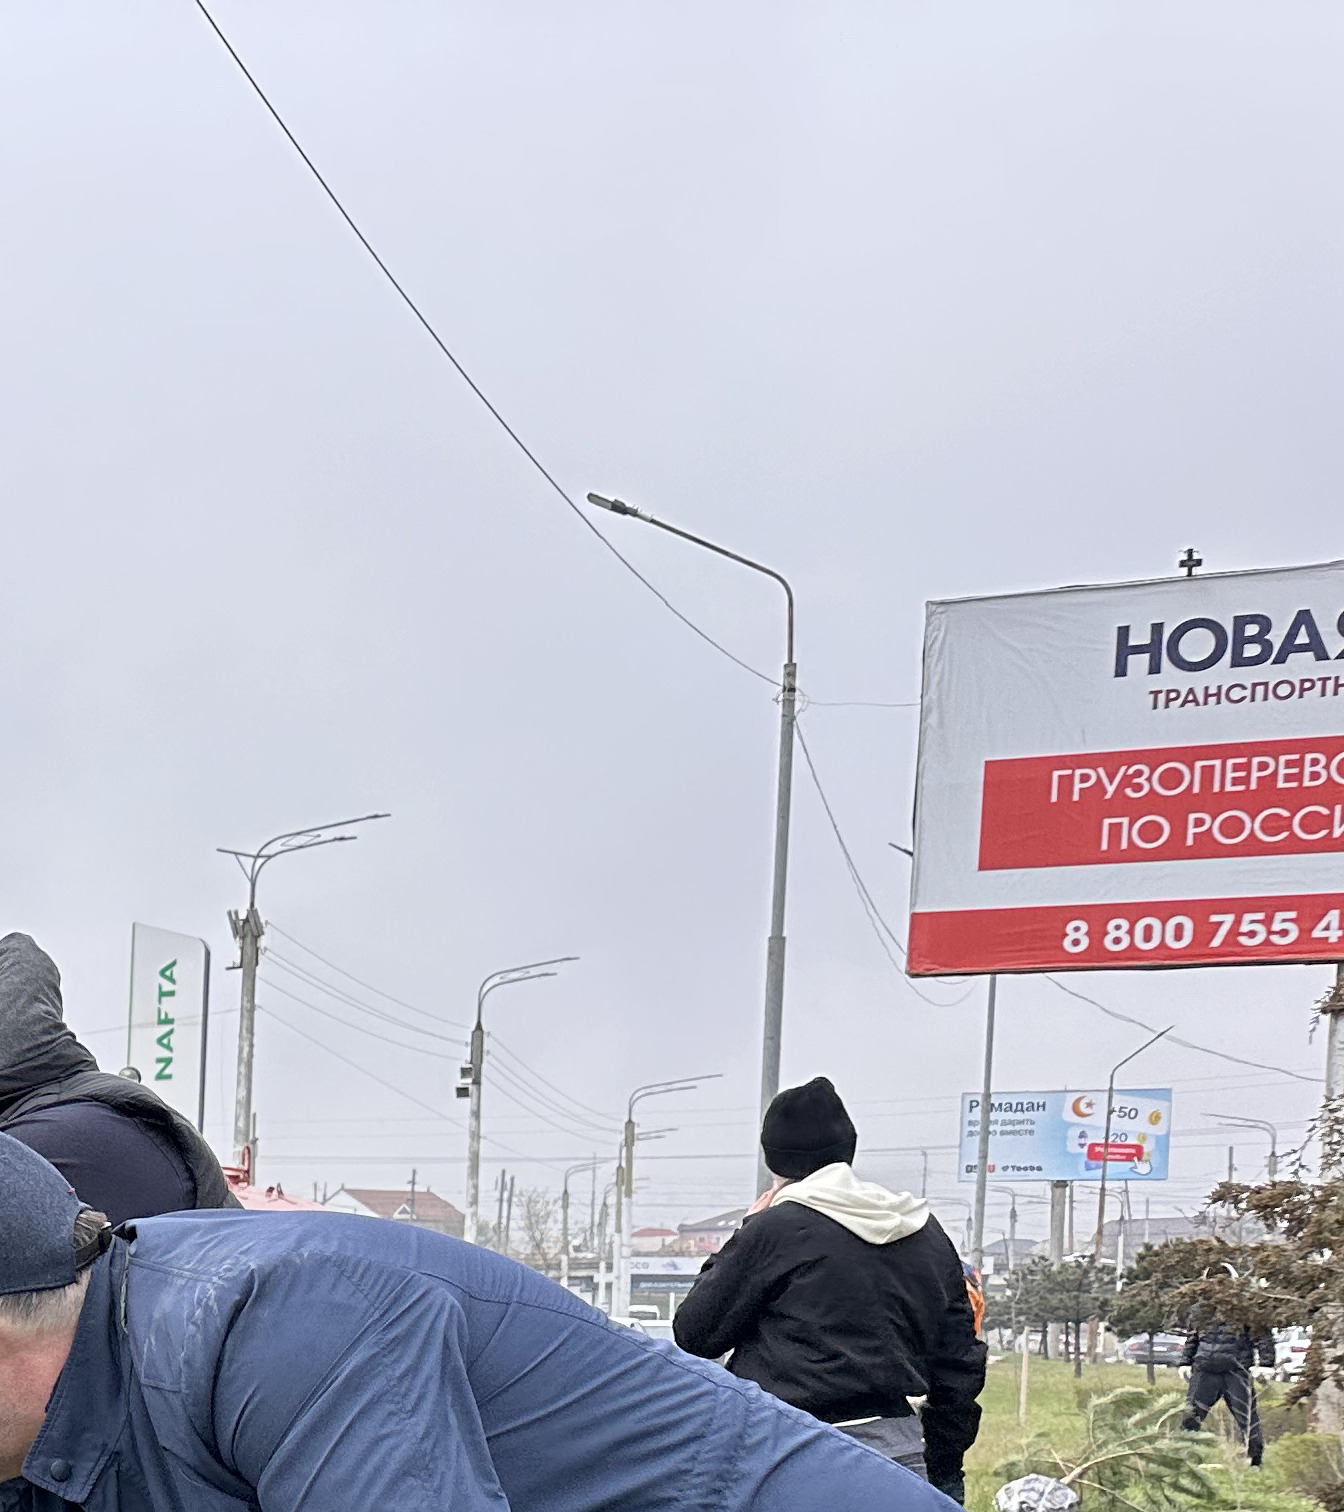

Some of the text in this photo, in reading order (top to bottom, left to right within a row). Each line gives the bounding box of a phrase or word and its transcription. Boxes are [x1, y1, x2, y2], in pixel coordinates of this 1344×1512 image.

[1114, 609, 1344, 678] НОВА
[1100, 814, 1171, 851] ПО
[1063, 908, 1344, 953] 8 800 755 4
[154, 958, 178, 1081] NAFTA
[968, 1099, 1047, 1114] Рмадан
[1104, 1132, 1128, 1143] 20
